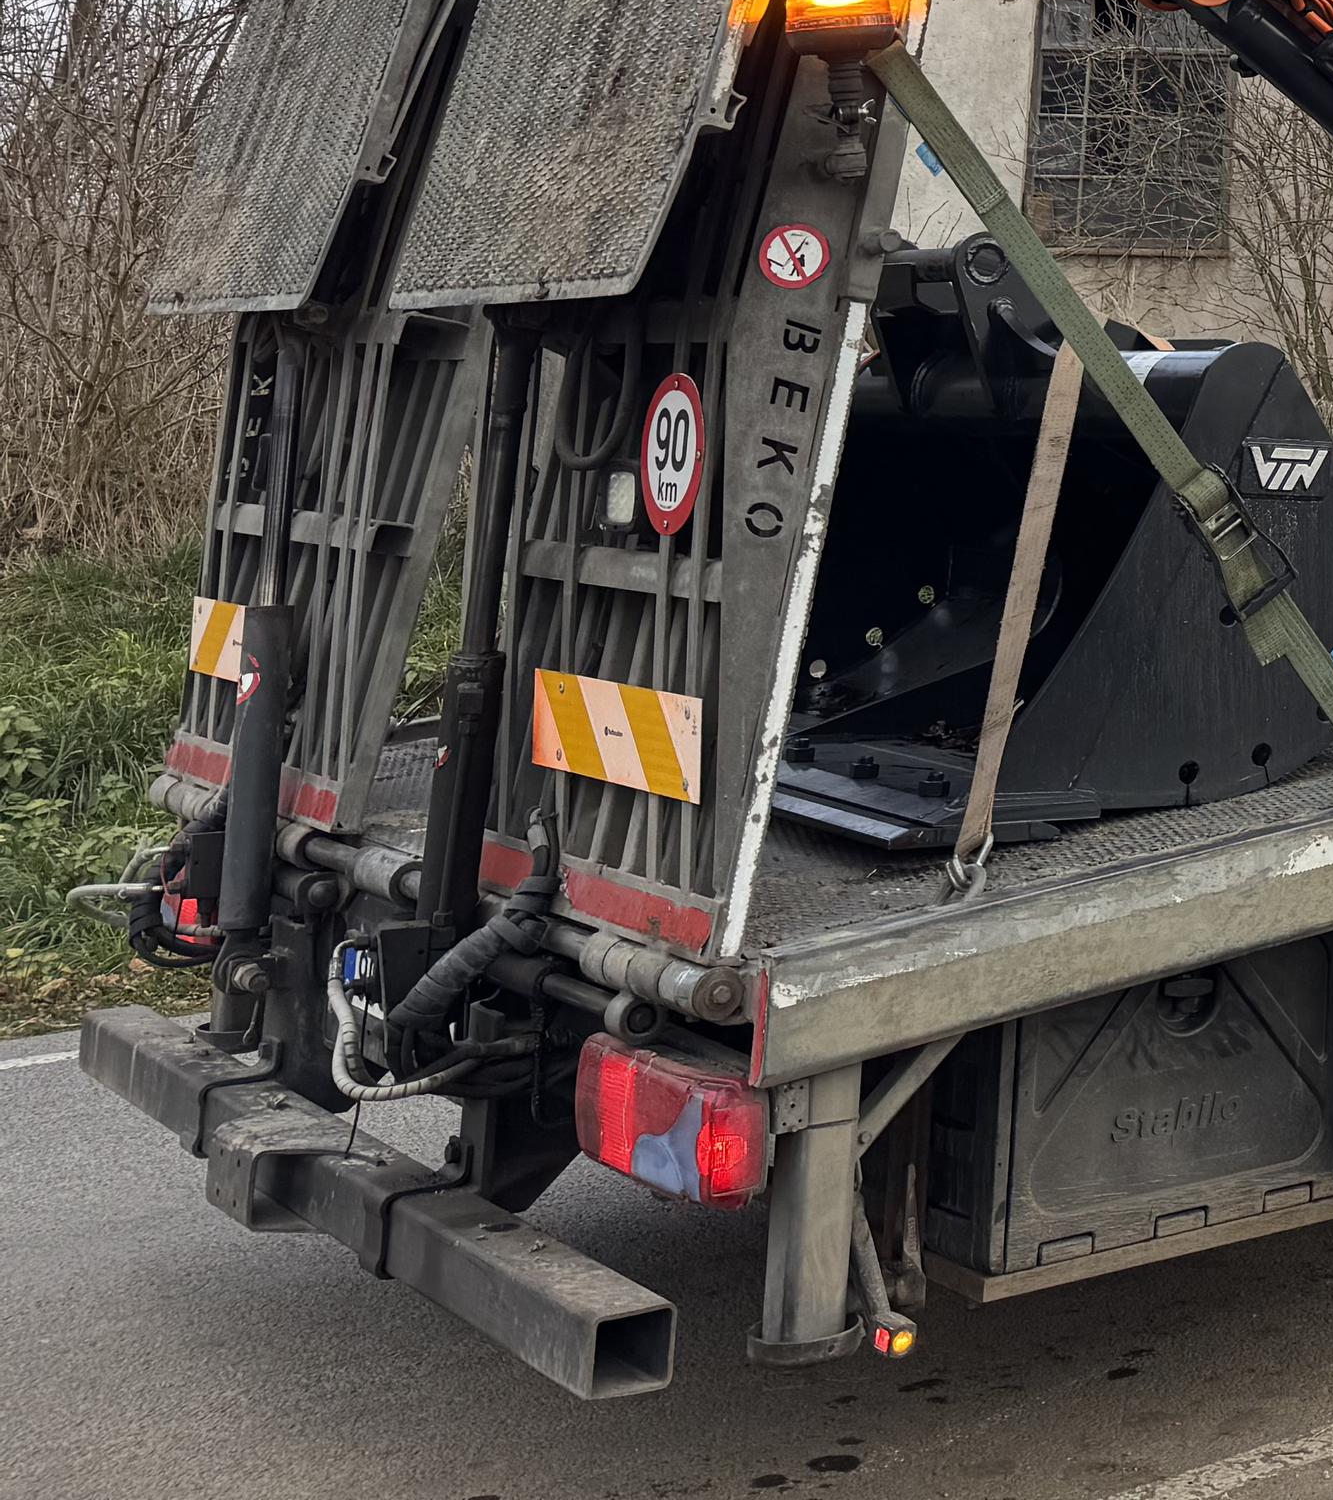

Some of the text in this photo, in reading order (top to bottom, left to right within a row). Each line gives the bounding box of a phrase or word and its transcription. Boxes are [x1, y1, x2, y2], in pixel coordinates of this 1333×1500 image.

[654, 407, 689, 473] 90
[744, 318, 823, 538] BEKO
[657, 473, 678, 503] km
[1110, 1090, 1241, 1143] Stabilo
